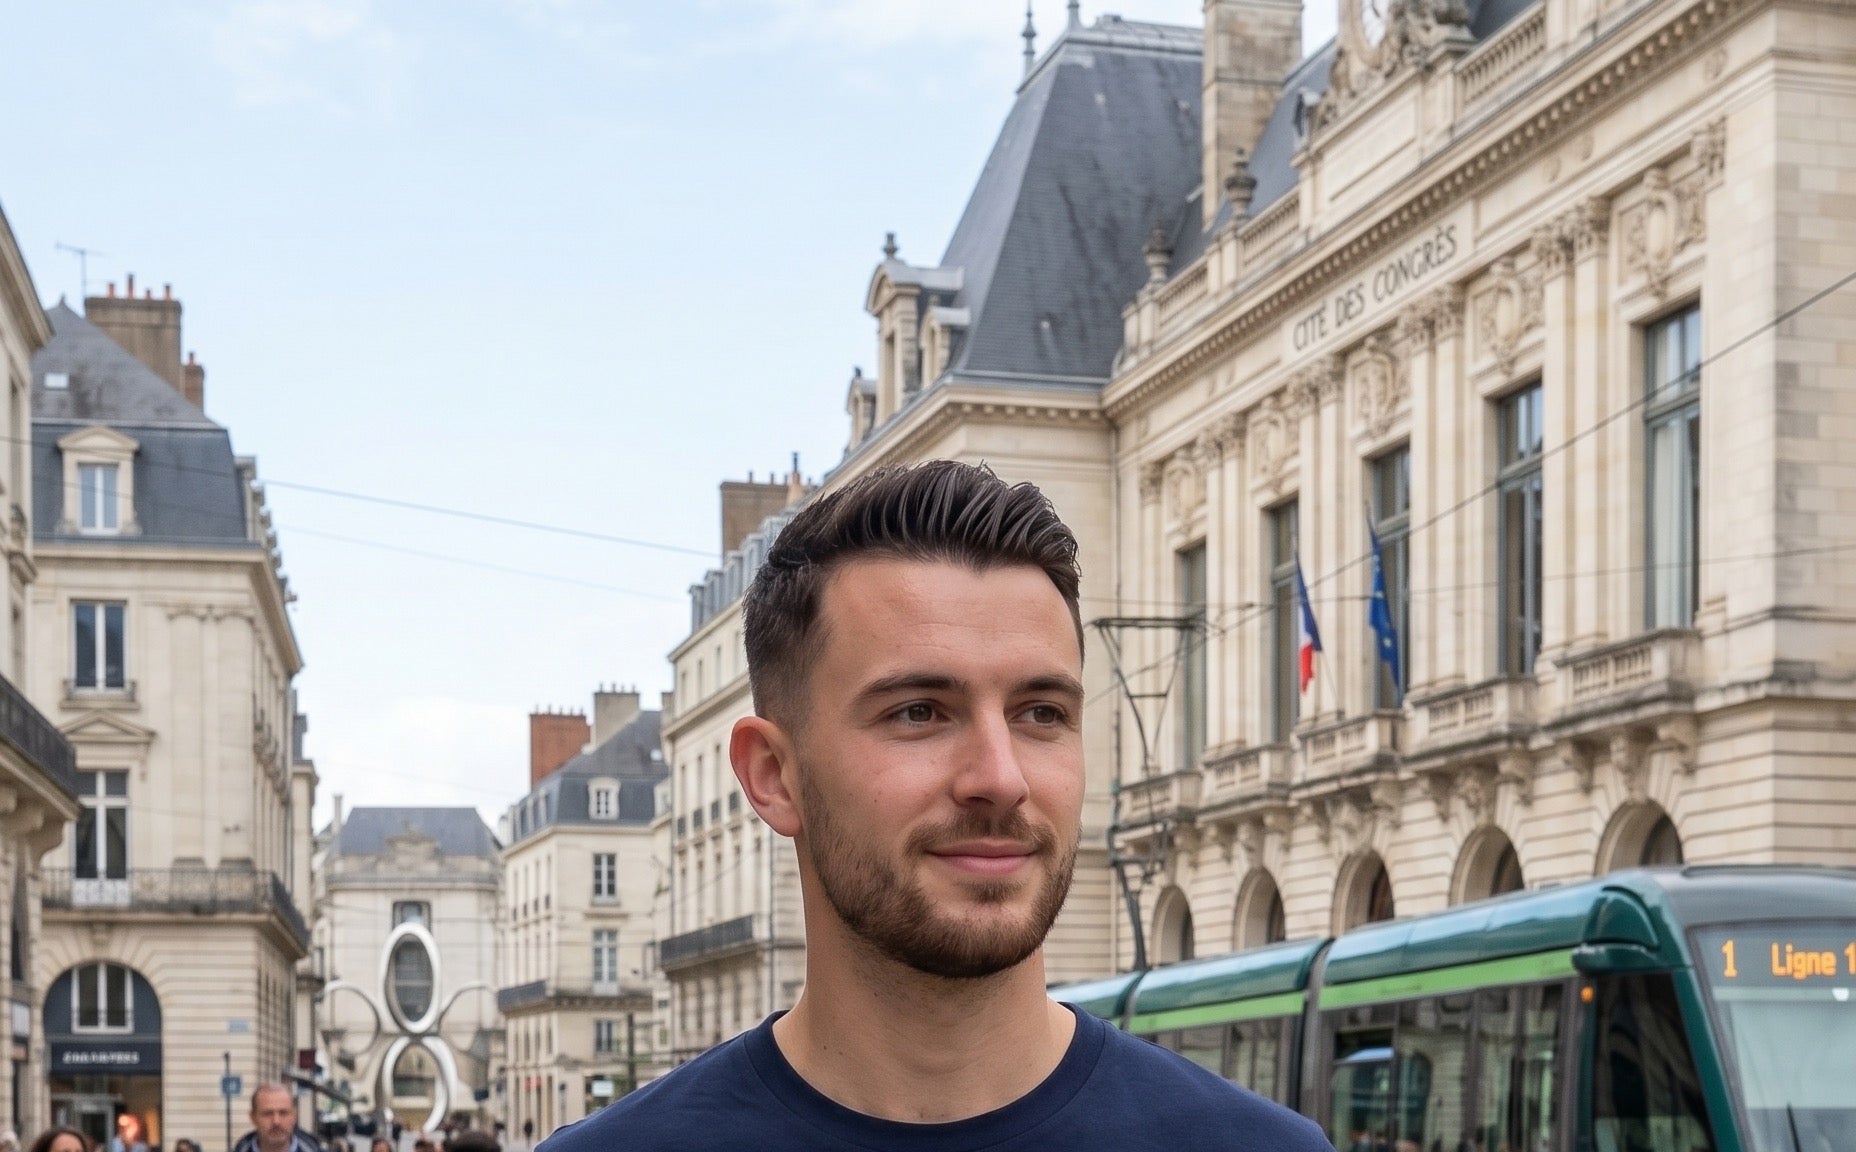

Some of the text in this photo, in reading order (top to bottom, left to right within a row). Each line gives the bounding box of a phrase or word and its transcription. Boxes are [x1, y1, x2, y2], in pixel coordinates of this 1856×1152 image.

[1334, 281, 1366, 328] DES
[1721, 939, 1738, 978] 1
[1771, 942, 1837, 980] Ligne
